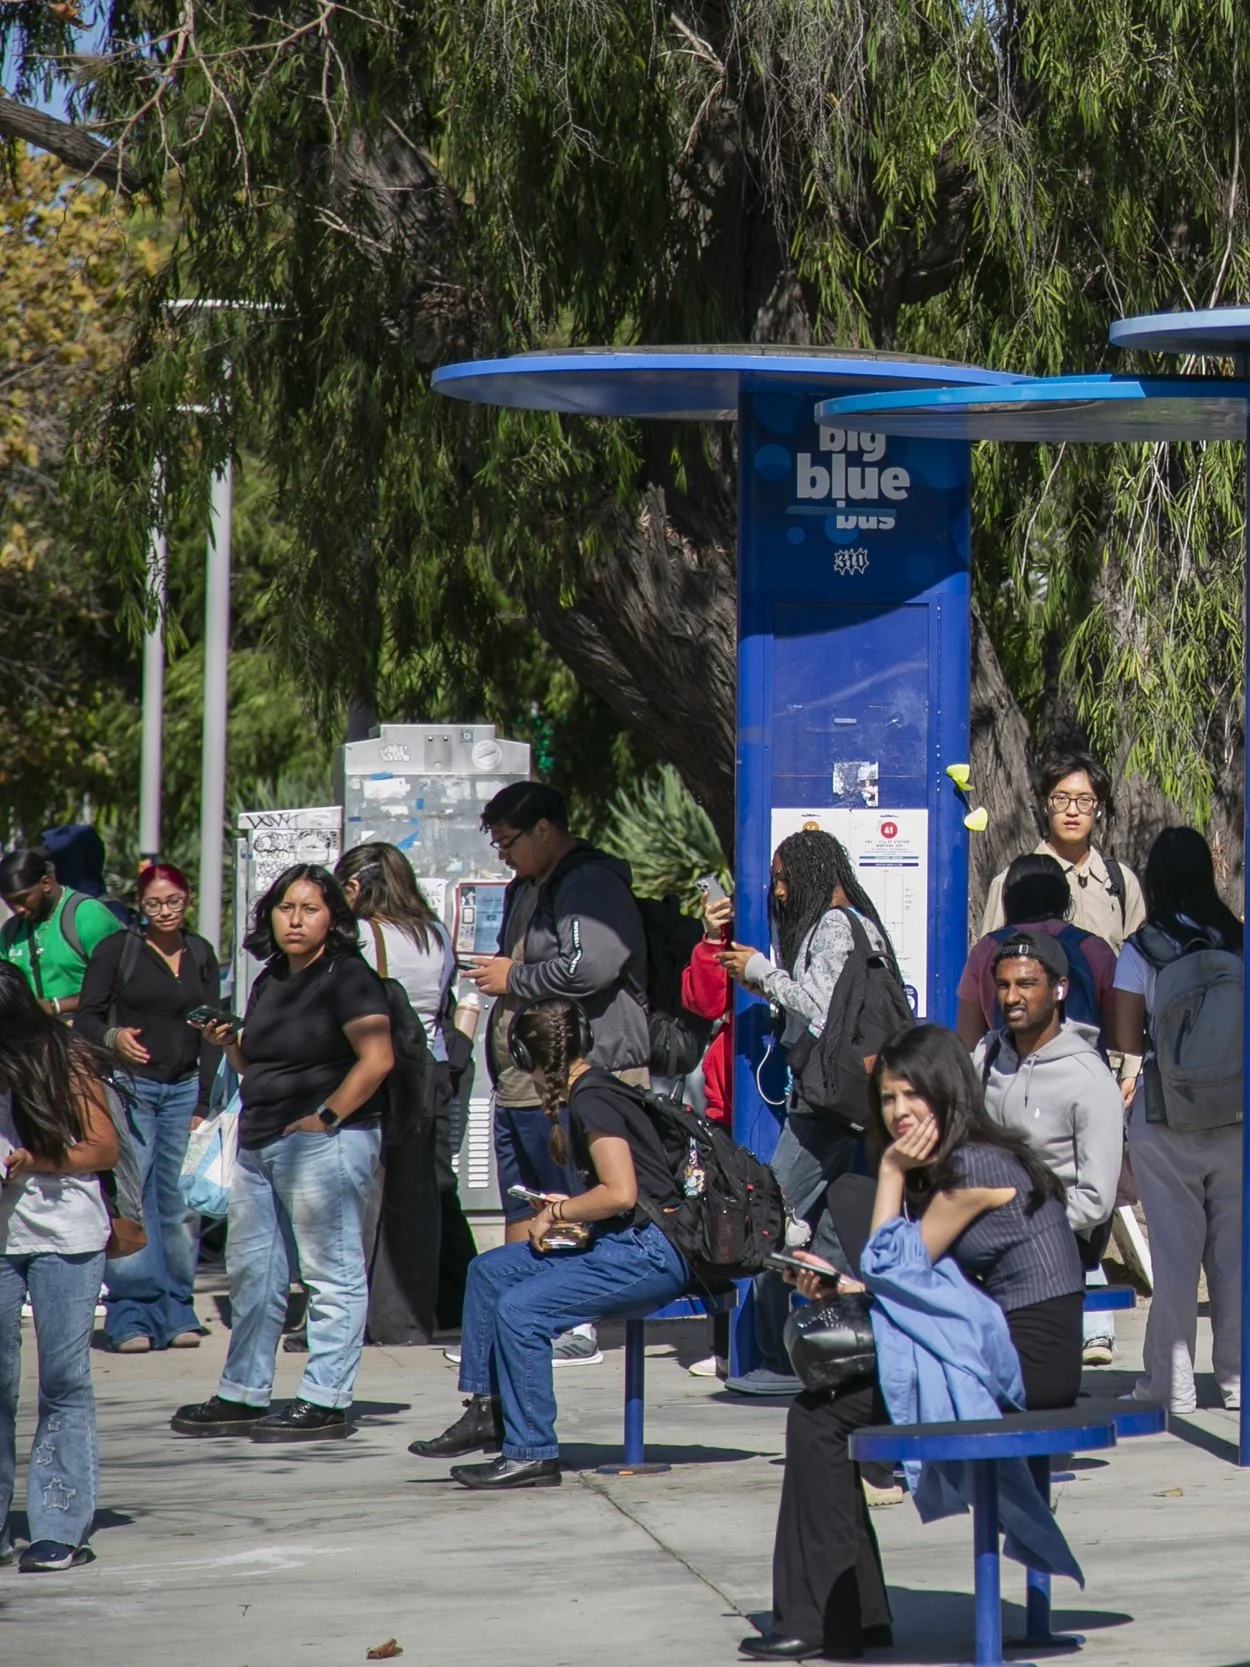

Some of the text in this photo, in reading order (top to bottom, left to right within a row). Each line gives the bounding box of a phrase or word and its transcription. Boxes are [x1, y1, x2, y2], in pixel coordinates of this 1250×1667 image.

[820, 426, 885, 462] big
[797, 453, 910, 500] blue
[836, 501, 895, 529] bus
